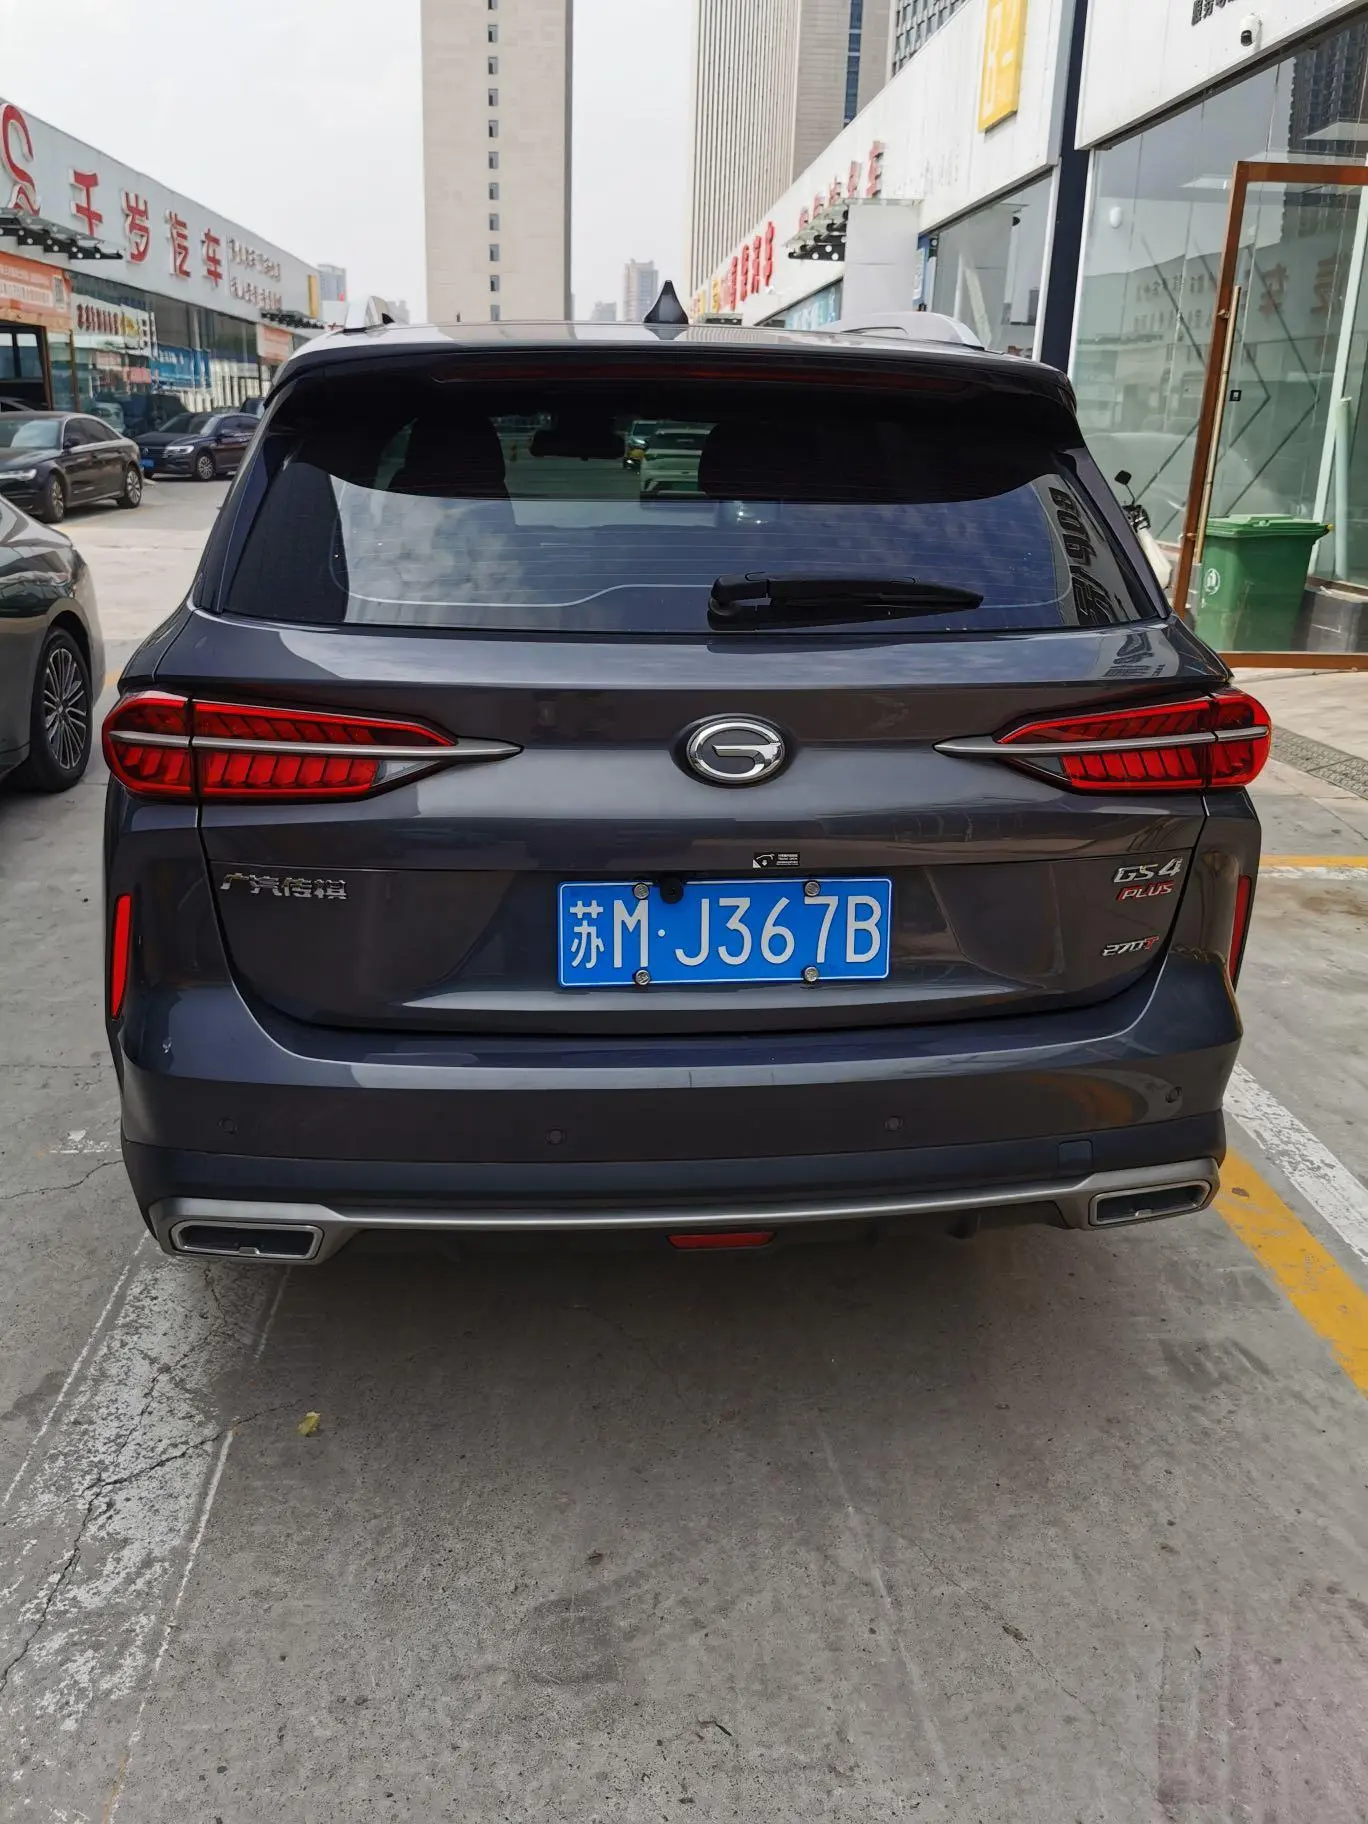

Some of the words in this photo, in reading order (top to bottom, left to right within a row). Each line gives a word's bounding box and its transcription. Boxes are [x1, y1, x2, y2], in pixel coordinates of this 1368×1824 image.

[70, 167, 224, 289] 千岁汽车
[219, 872, 347, 899] 广汽传祺
[1116, 880, 1176, 901] PLUS
[1102, 935, 1160, 956] 270T
